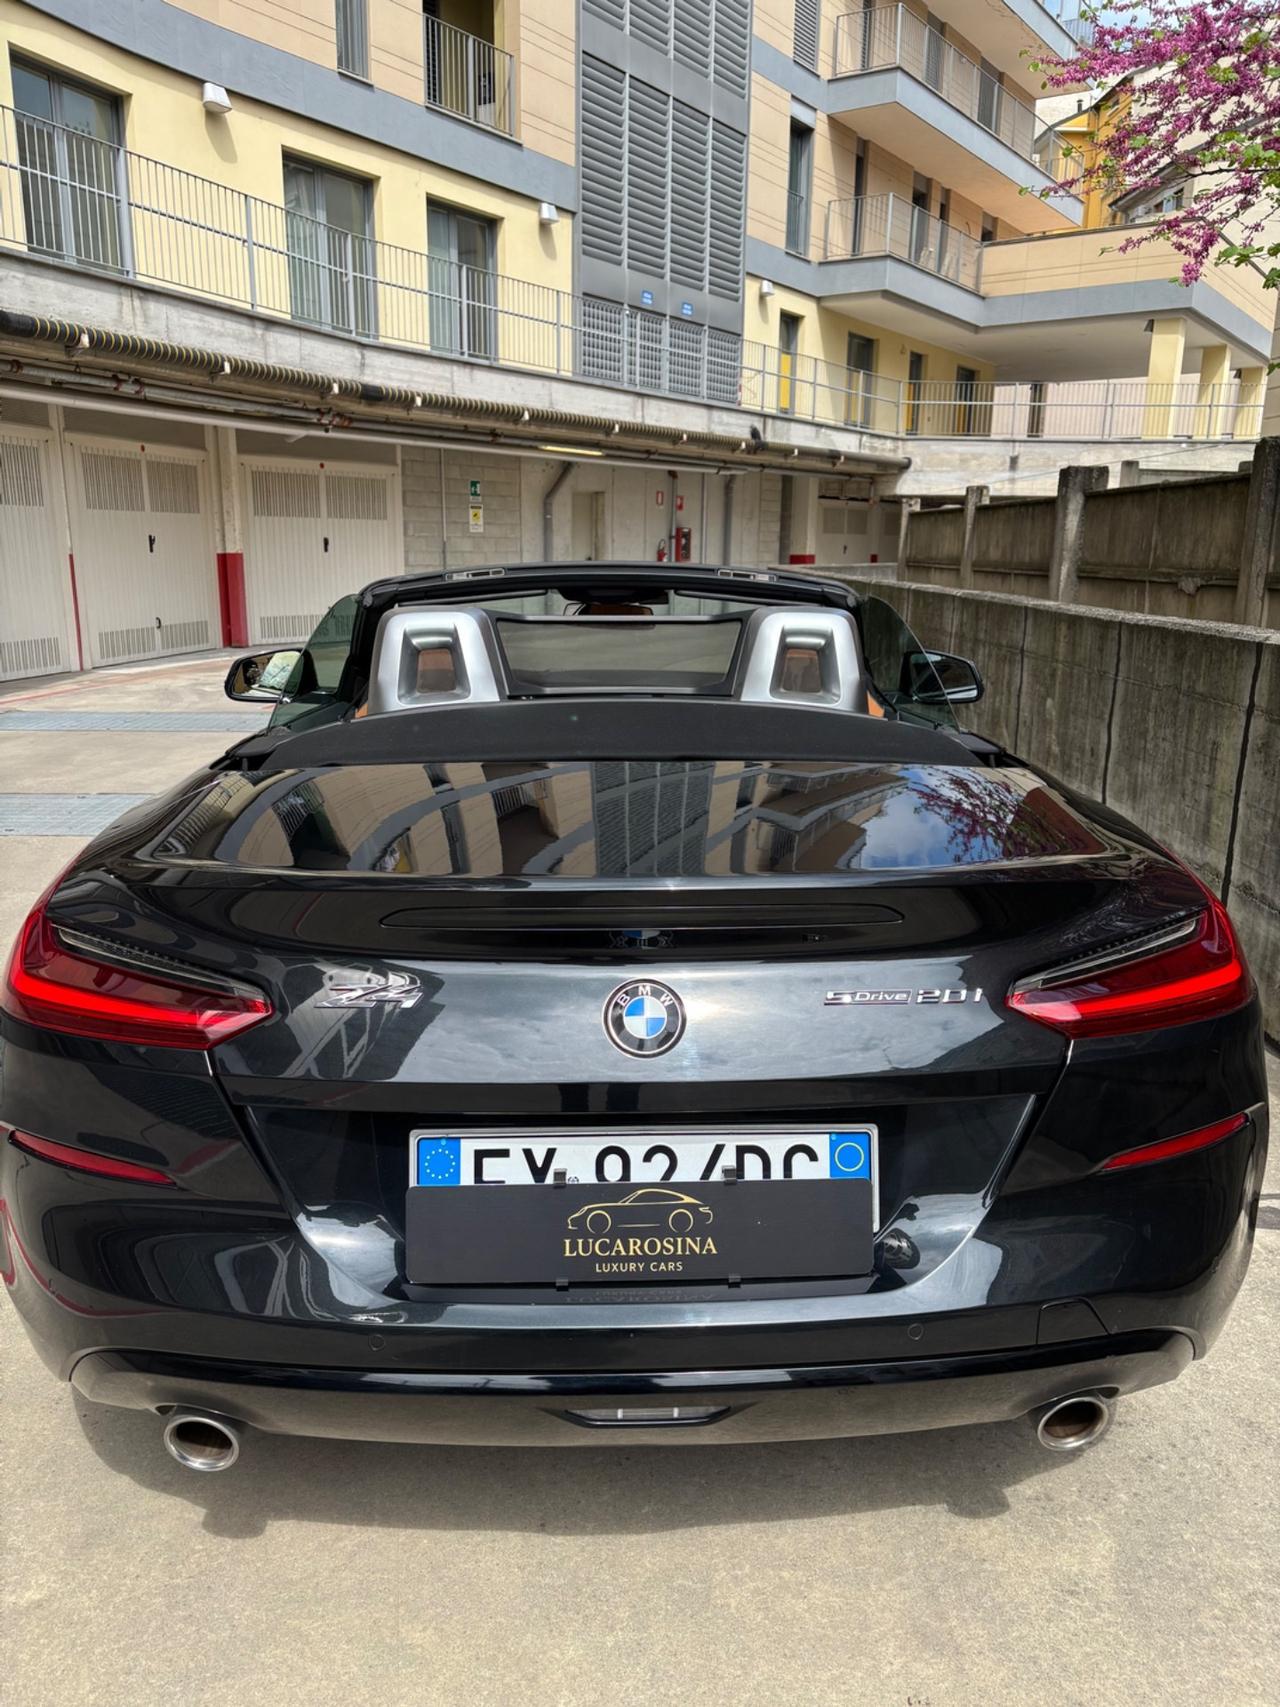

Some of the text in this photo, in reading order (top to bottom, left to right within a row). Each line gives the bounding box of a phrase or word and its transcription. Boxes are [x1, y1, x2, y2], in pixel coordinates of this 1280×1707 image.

[314, 984, 423, 1008] Z4
[617, 985, 674, 1007] BMW
[564, 1237, 718, 1257] LUCAROSINA
[595, 1261, 683, 1273] LUXURY CARS
